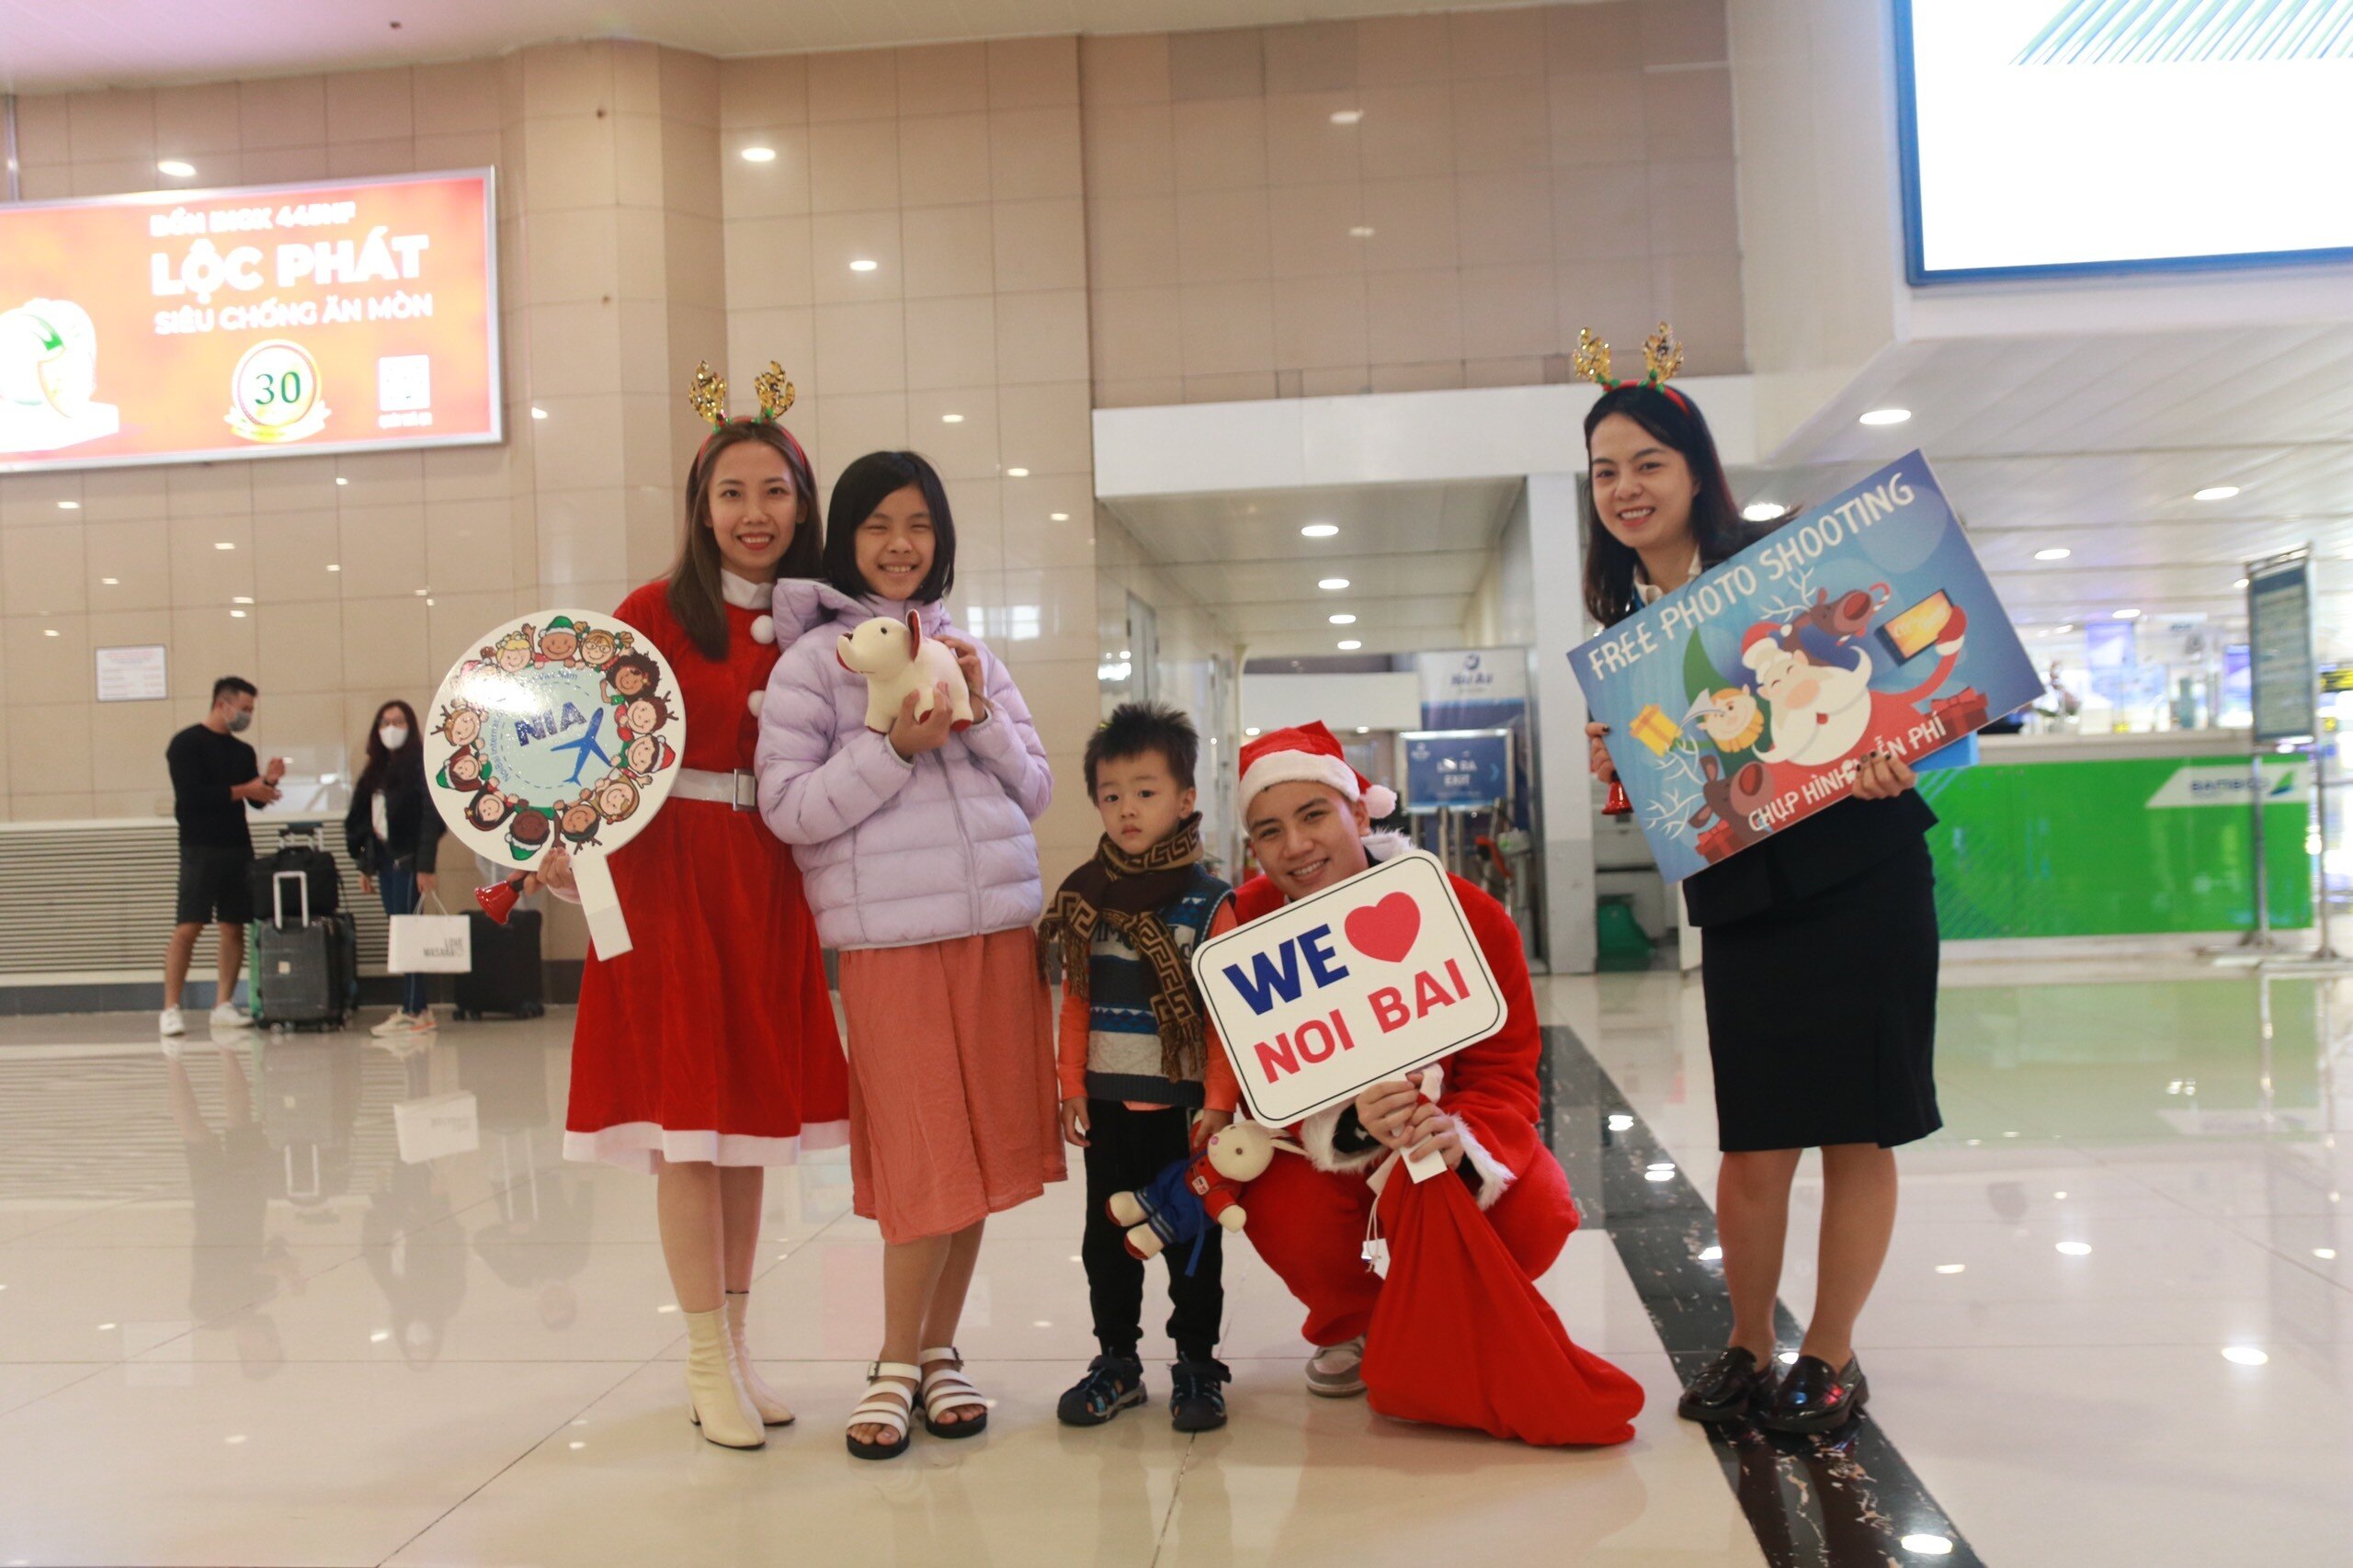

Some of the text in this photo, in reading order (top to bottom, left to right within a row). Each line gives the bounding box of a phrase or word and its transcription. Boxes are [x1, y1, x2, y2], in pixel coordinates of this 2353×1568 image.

[151, 225, 429, 304] LỘC PHÁT
[154, 290, 433, 335] SIÊU CHỐNG ĂN MÒN
[255, 371, 301, 405] 30
[1588, 472, 1915, 681] FREE PHOTO SHOOTING
[514, 701, 587, 747] NIA
[1748, 791, 1800, 832] CHỤP
[1907, 710, 1947, 750] PHÍ
[1222, 923, 1350, 1016] WE
[1253, 958, 1471, 1085] NOI BAI
